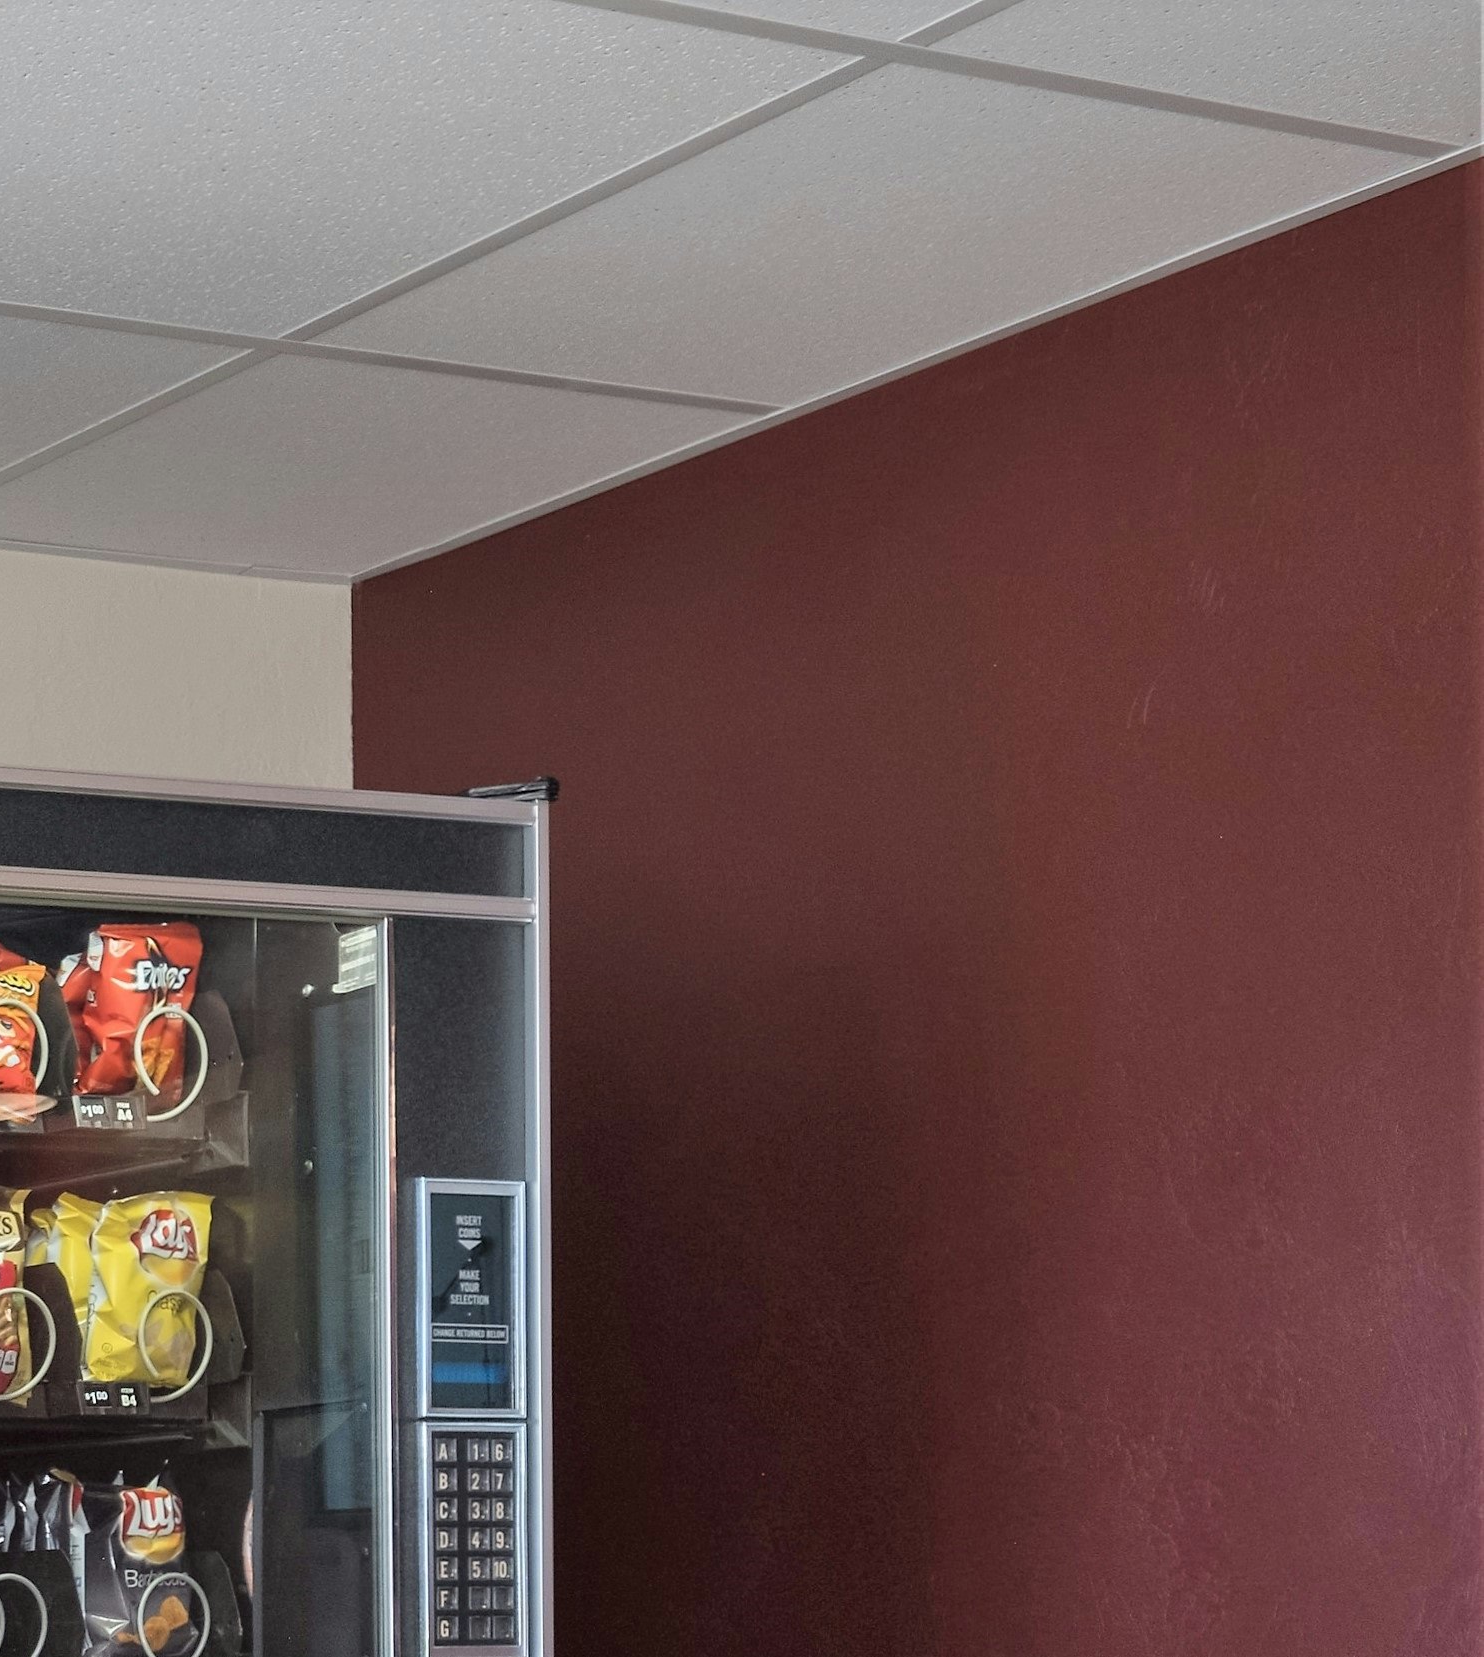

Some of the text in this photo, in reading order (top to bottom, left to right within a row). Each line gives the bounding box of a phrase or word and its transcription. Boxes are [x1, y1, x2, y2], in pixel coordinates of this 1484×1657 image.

[117, 1109, 133, 1121] A4
[456, 1215, 482, 1226] INSERT
[458, 1228, 481, 1239] COINS
[459, 1270, 480, 1281] MAKE
[460, 1282, 480, 1292] YOUR
[450, 1294, 489, 1305] SELECTION
[456, 1329, 485, 1337] RETURNED
[121, 1395, 137, 1407] B4
[439, 1444, 448, 1460] A
[472, 1444, 478, 1460] 1
[495, 1444, 504, 1460] 6
[439, 1473, 448, 1489] B
[472, 1473, 480, 1489] 2
[496, 1473, 503, 1489] 7
[439, 1502, 449, 1519] C
[472, 1503, 480, 1519] 3
[496, 1503, 504, 1519] 8
[439, 1532, 449, 1548] D
[471, 1532, 480, 1548] 4
[496, 1532, 504, 1549] 9
[440, 1561, 449, 1578] E
[472, 1561, 481, 1578] 5
[494, 1561, 507, 1577] 10
[440, 1590, 449, 1607] F
[440, 1620, 449, 1637] G
